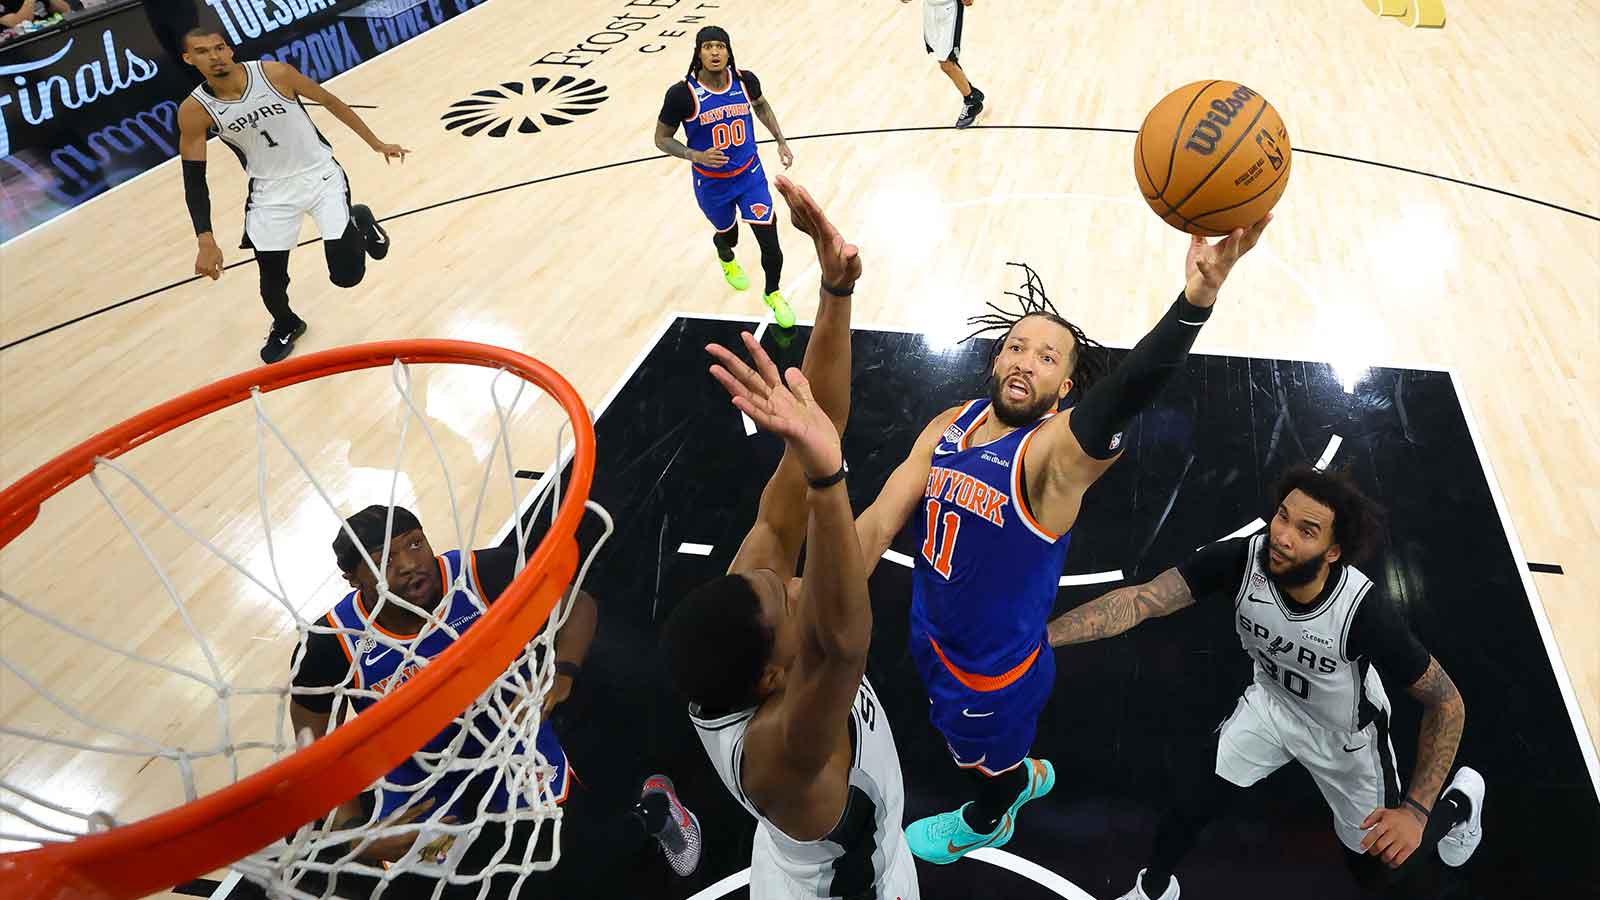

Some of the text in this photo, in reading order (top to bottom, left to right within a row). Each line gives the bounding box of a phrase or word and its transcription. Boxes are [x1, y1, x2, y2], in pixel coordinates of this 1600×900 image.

[204, 0, 337, 45] TUES
[227, 103, 287, 132] SPURS
[699, 106, 725, 126] NEW
[711, 118, 747, 150] 00
[260, 130, 279, 148] 1
[944, 468, 1009, 528] YORK
[921, 498, 961, 581] 11
[1239, 613, 1337, 674] SPURS
[1256, 648, 1309, 701] 30
